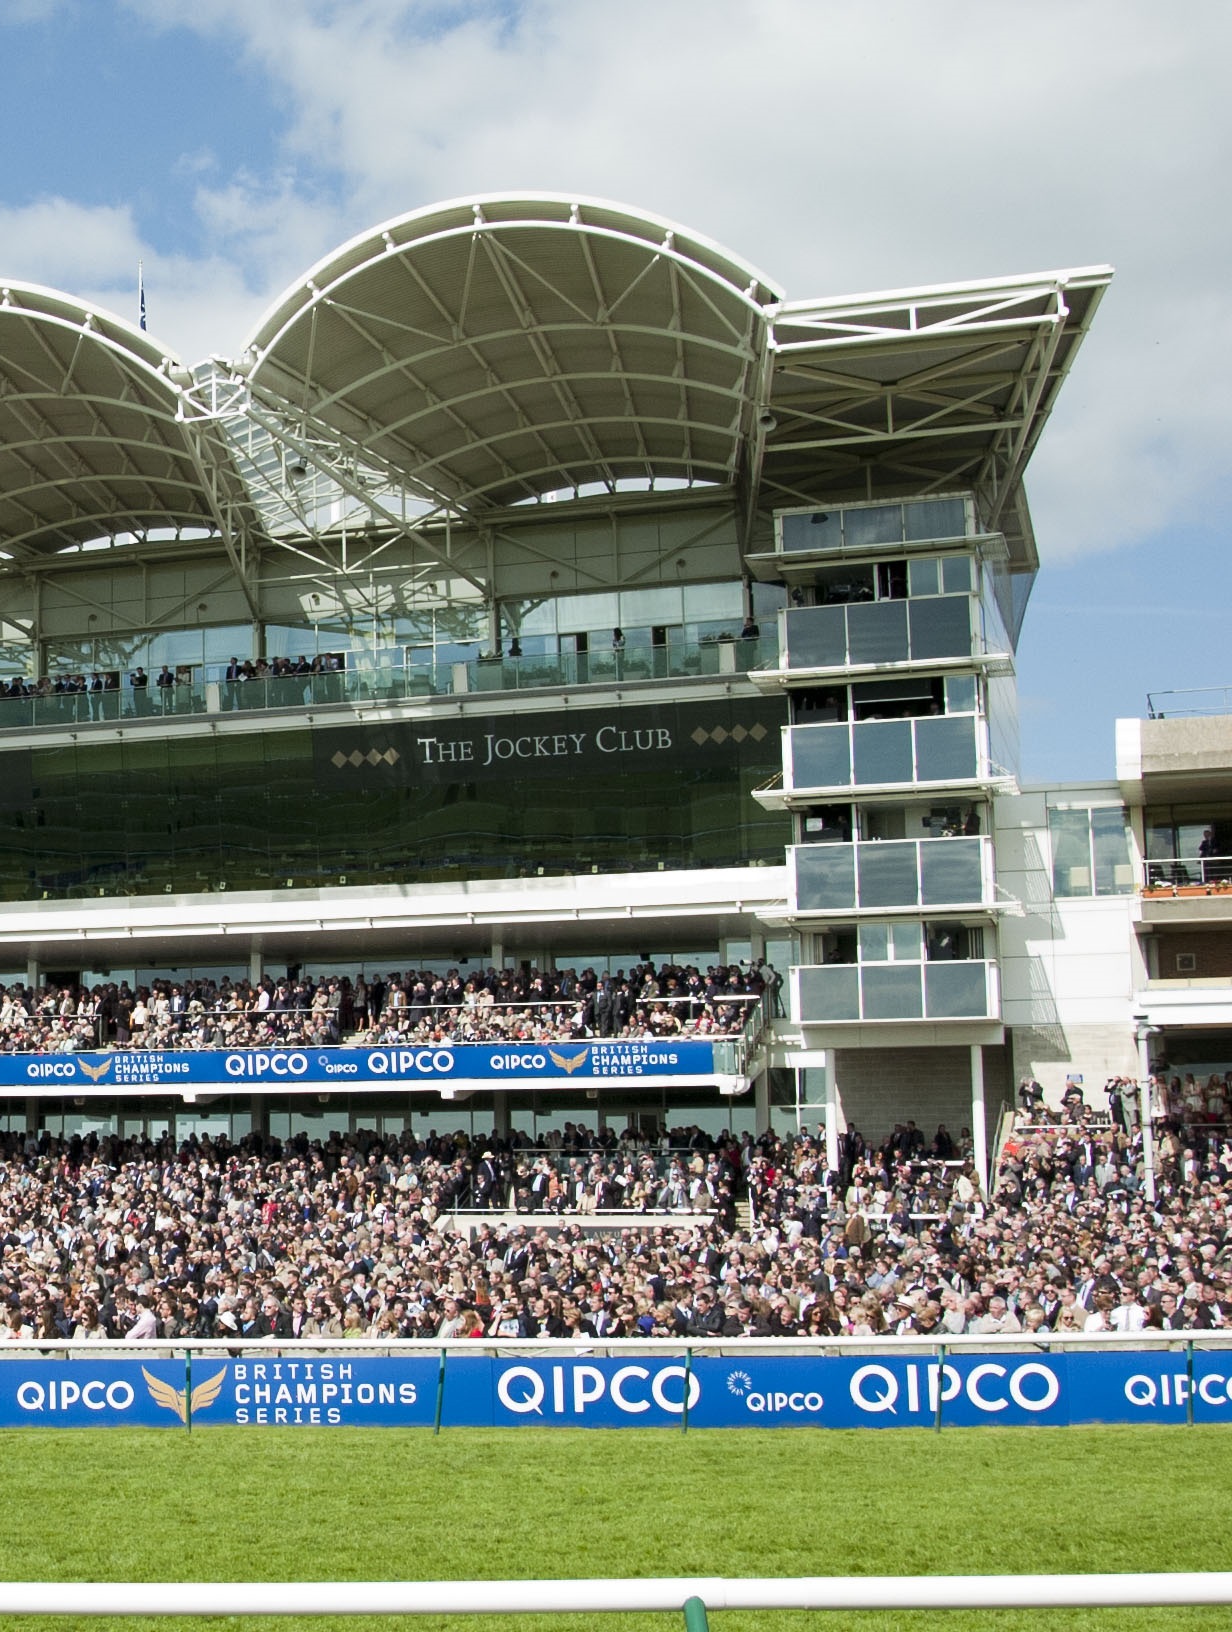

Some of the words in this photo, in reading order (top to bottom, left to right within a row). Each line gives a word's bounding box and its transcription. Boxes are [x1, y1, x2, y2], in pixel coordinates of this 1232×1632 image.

[483, 733, 586, 766] JOCKEY
[596, 726, 672, 753] CLUB
[592, 1046, 648, 1055] BRITISH
[115, 1063, 190, 1074] CHAMPIONS
[225, 1053, 308, 1075] QIPCO
[326, 1063, 358, 1073] QIPCO
[367, 1050, 455, 1074] QIPCO
[489, 1054, 546, 1070] QIPCO
[592, 1054, 678, 1066] CHAMPIONS
[27, 1063, 76, 1078] QIPCO
[592, 1066, 643, 1075] SERIES
[235, 1364, 355, 1379] BRITISH
[17, 1381, 135, 1411] QIPCO
[235, 1384, 417, 1404] CHAMPIONS
[497, 1364, 701, 1415] QIPCO
[849, 1362, 1060, 1415] QIPCO
[1124, 1374, 1232, 1407] QIPC
[746, 1392, 824, 1412] QIPCO
[235, 1407, 341, 1424] SERIES
